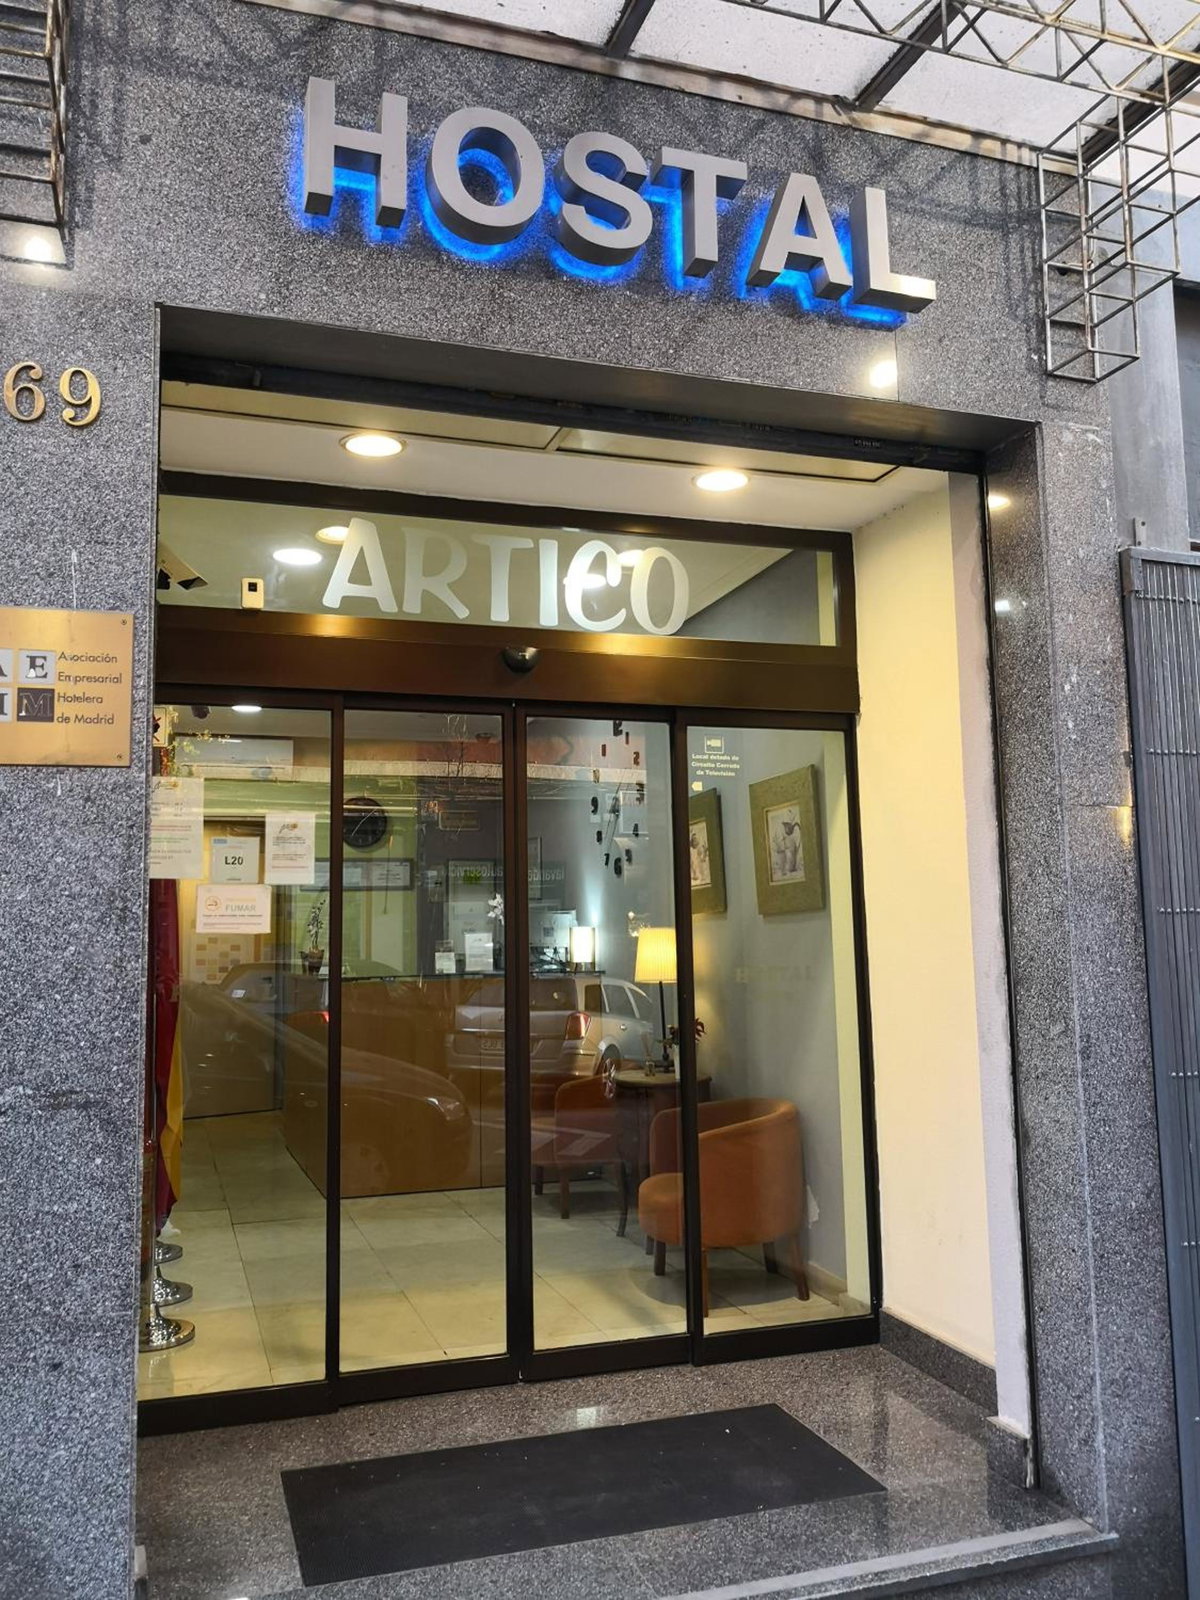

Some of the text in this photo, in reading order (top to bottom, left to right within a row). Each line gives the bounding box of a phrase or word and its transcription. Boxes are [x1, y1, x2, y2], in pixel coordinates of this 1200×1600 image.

[304, 76, 937, 314] HOSTAL
[4, 362, 101, 426] 69
[322, 517, 690, 636] ARTICO
[58, 651, 118, 664] Asociación
[57, 671, 123, 685] Empresarial
[57, 692, 104, 704] Hotelera
[56, 712, 115, 725] de Madrid
[224, 856, 244, 866] L20
[225, 904, 256, 913] FUMAR
